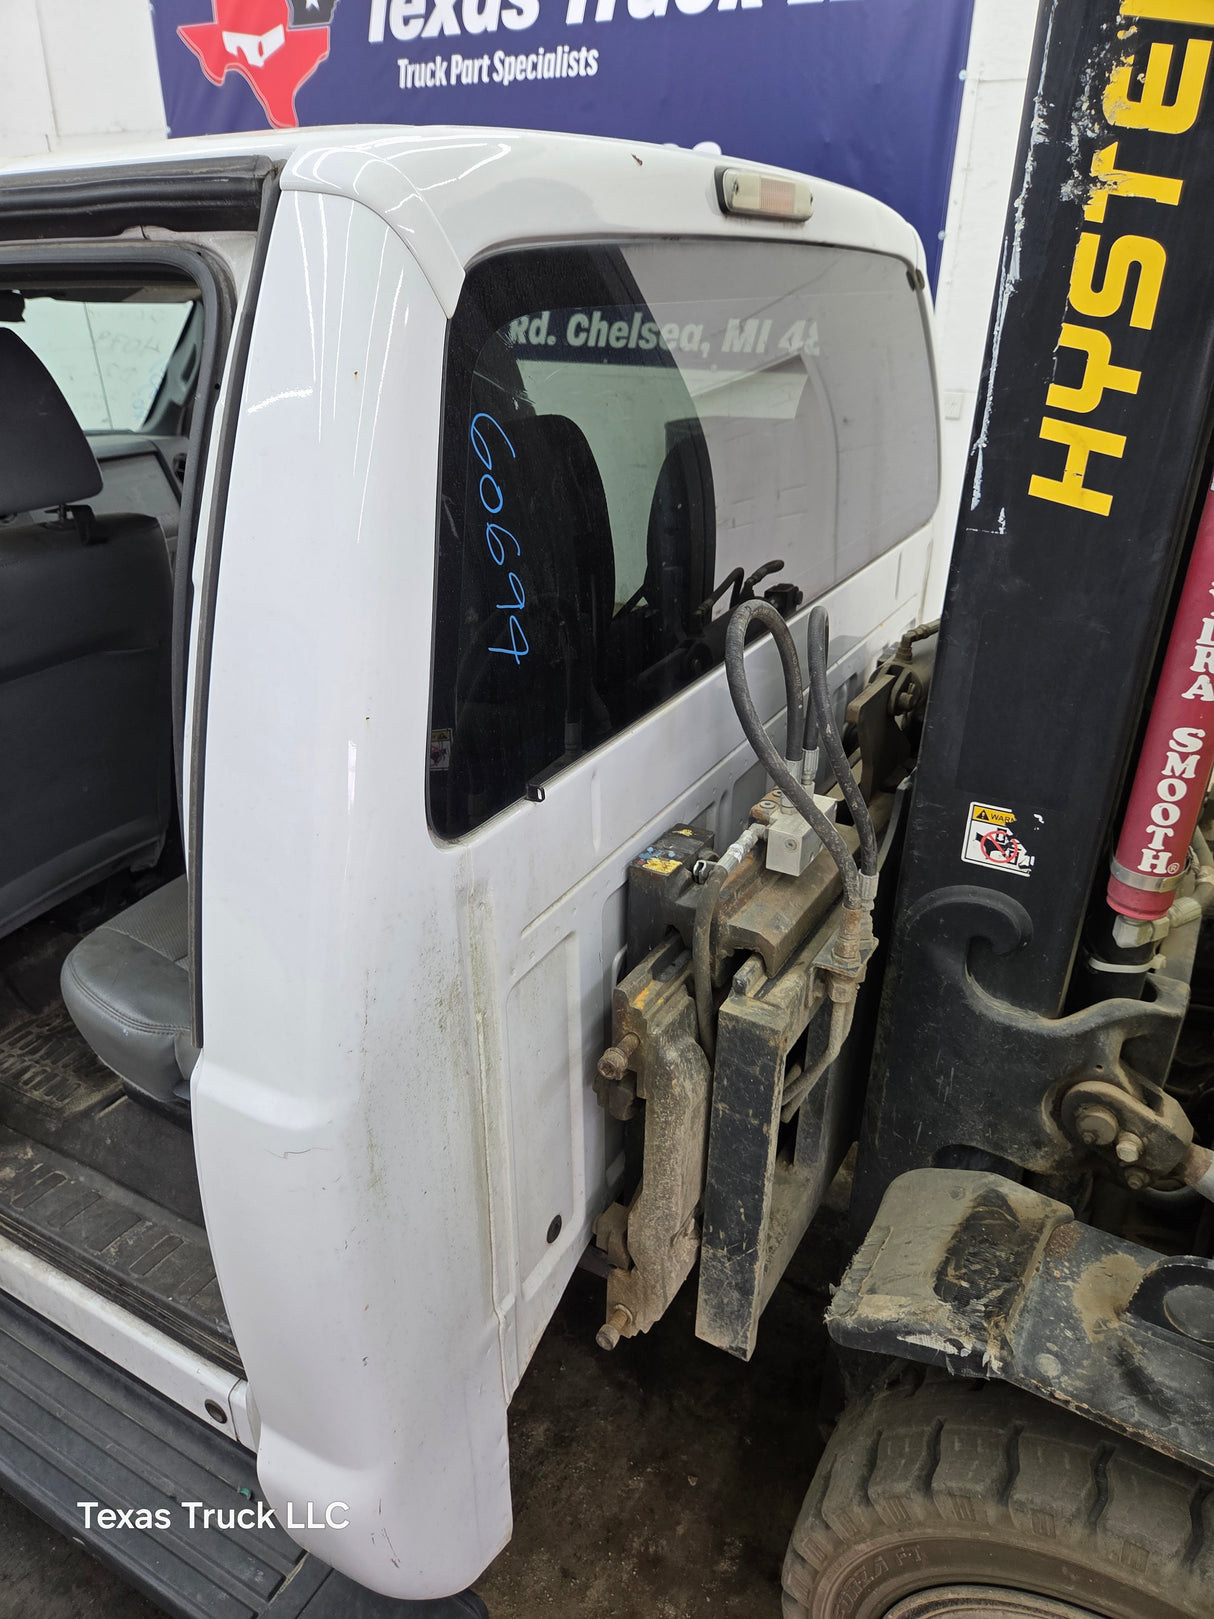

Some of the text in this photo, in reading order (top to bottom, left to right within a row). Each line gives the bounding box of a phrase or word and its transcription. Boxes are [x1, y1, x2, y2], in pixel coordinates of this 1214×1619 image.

[398, 45, 599, 89] Truck Part Specialists
[1028, 0, 1214, 517] HYSTE
[565, 310, 710, 357] Chelsea,
[720, 317, 773, 354] MI
